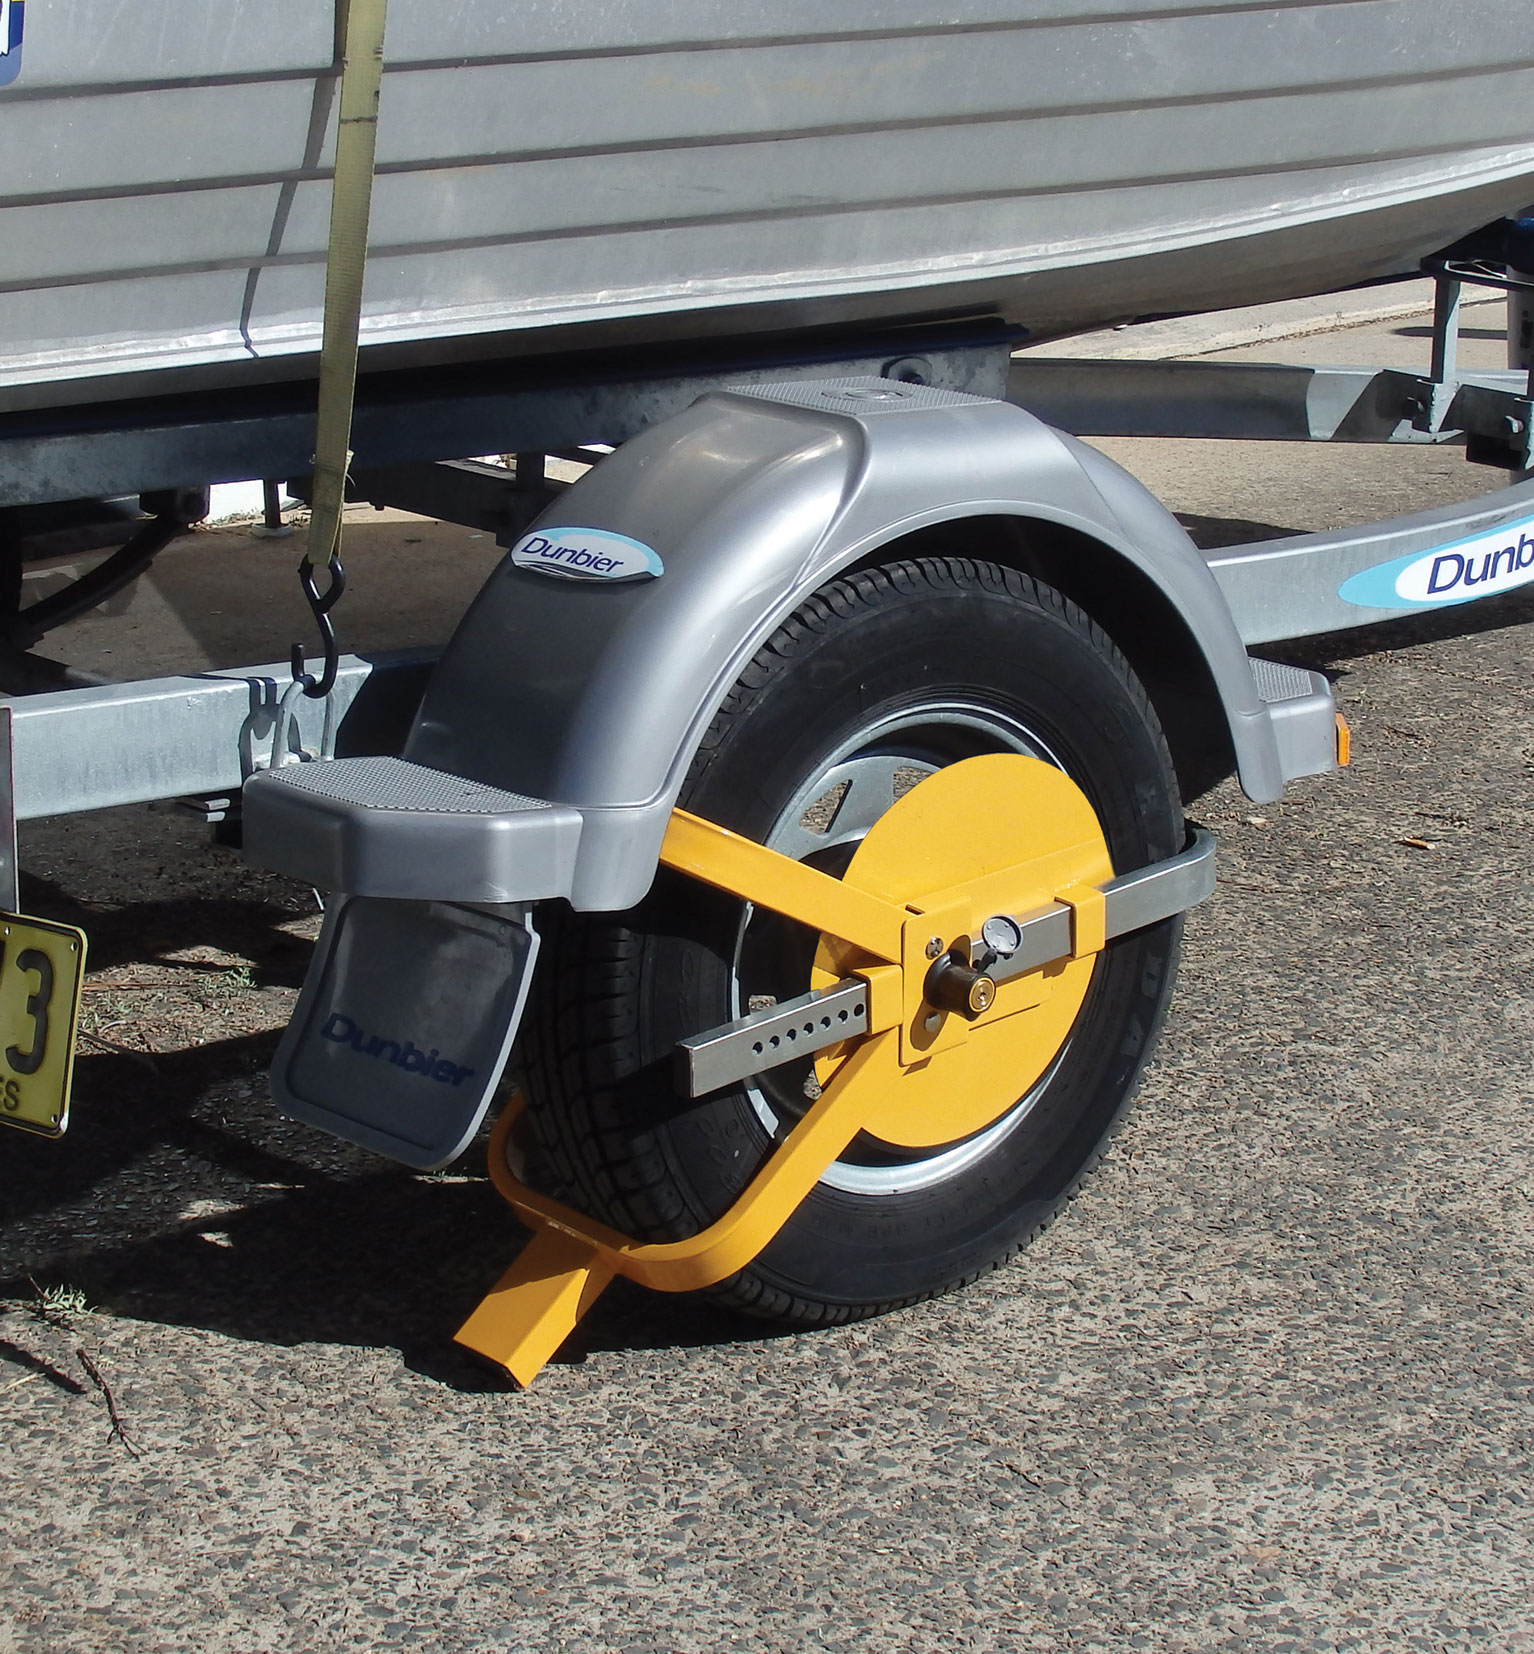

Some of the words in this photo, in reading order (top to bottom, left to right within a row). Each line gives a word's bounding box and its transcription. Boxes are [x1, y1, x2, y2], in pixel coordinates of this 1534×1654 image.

[521, 537, 624, 573] Dunbier
[1427, 533, 1534, 594] Dunb
[0, 941, 53, 1074] 3
[320, 1013, 475, 1086] Dunbier
